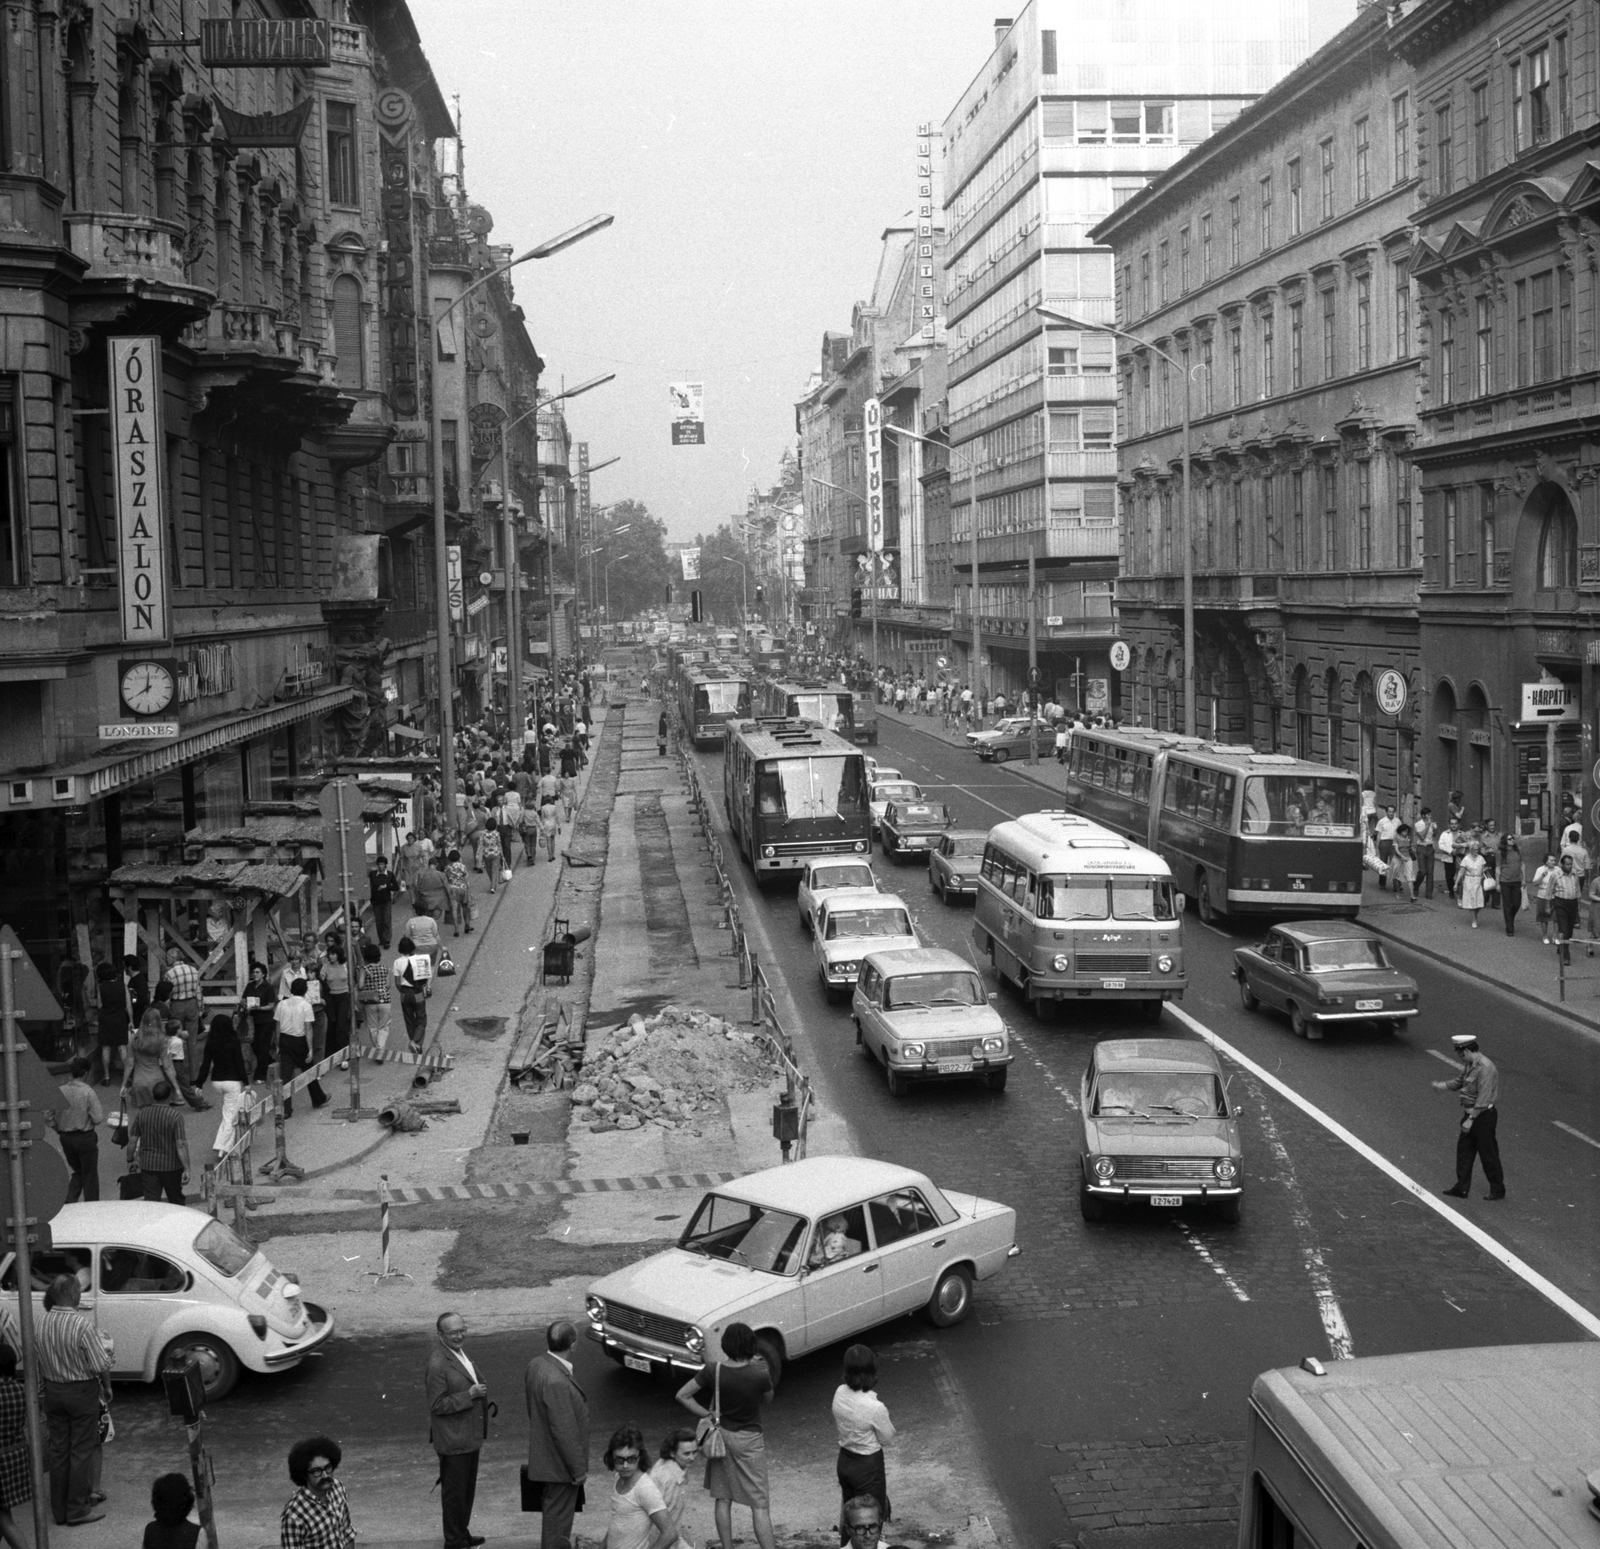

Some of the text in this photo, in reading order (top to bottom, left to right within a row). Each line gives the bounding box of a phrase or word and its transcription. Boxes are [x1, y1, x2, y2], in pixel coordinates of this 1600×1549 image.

[917, 123, 933, 318] HUNGAROTEX
[124, 347, 157, 630] ÓRASZALON
[1384, 699, 1401, 708] BÁV
[1532, 688, 1571, 706] KÁRPÁTIA
[104, 726, 174, 737] LONGINES
